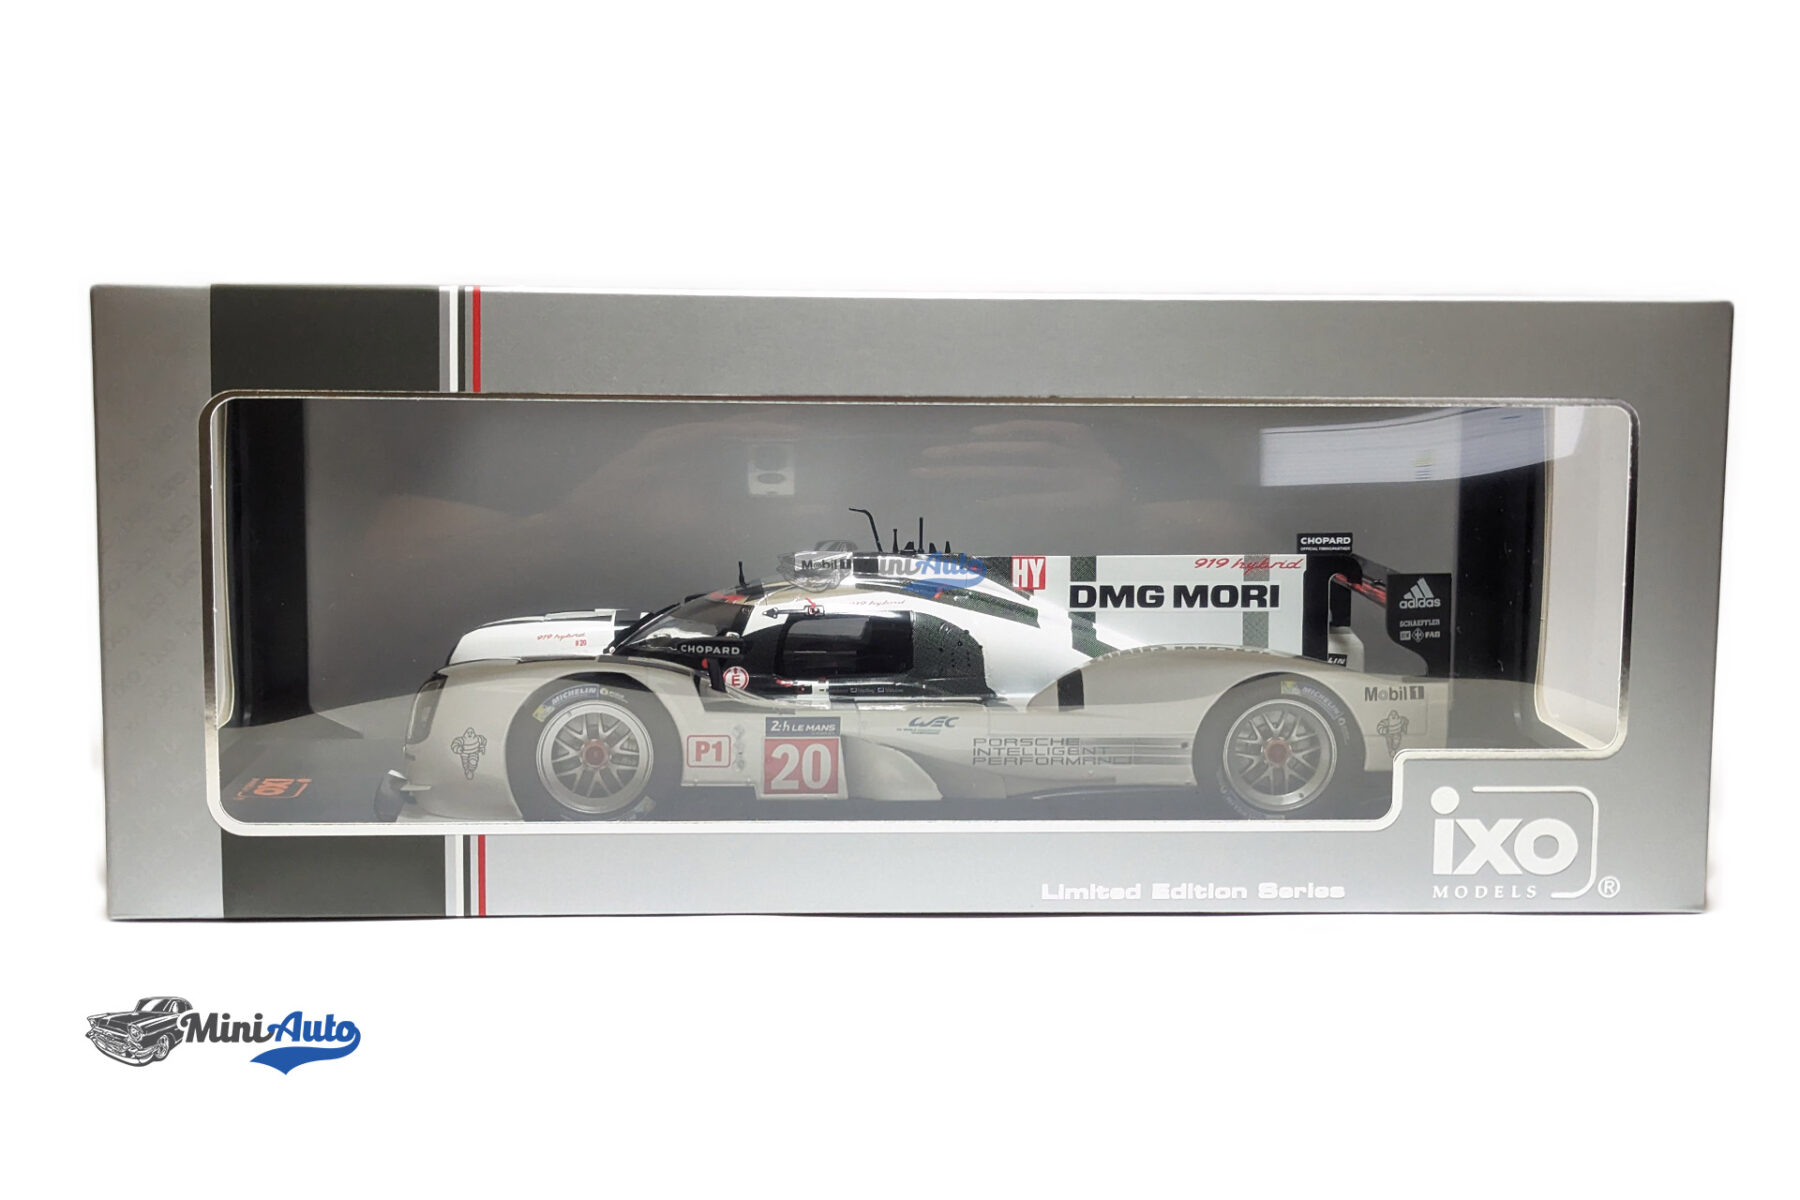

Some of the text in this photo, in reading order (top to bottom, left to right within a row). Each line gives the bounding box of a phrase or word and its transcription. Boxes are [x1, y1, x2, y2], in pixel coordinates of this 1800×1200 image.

[1300, 536, 1351, 545] CHOPARD
[801, 559, 838, 570] Mobil
[1194, 557, 1304, 575] 919 hybrid
[1012, 558, 1045, 588] HY
[1069, 584, 1280, 609] DMG MORI
[1399, 597, 1441, 609] adidas
[680, 644, 741, 656] CHOPARD
[731, 674, 741, 687] E
[551, 686, 598, 706] MICHELIN
[1364, 685, 1408, 701] Mobil
[1301, 685, 1341, 716] MICHELIN
[791, 724, 805, 732] LE
[805, 724, 837, 732] MANS
[908, 716, 961, 728] WEC
[973, 737, 1080, 747] PORSCHE
[694, 740, 723, 763] P1
[973, 747, 1107, 757] INTELLIGENT
[770, 743, 833, 791] 20
[1041, 882, 1346, 900] Limited Edition Series
[1432, 885, 1538, 899] MODELS
